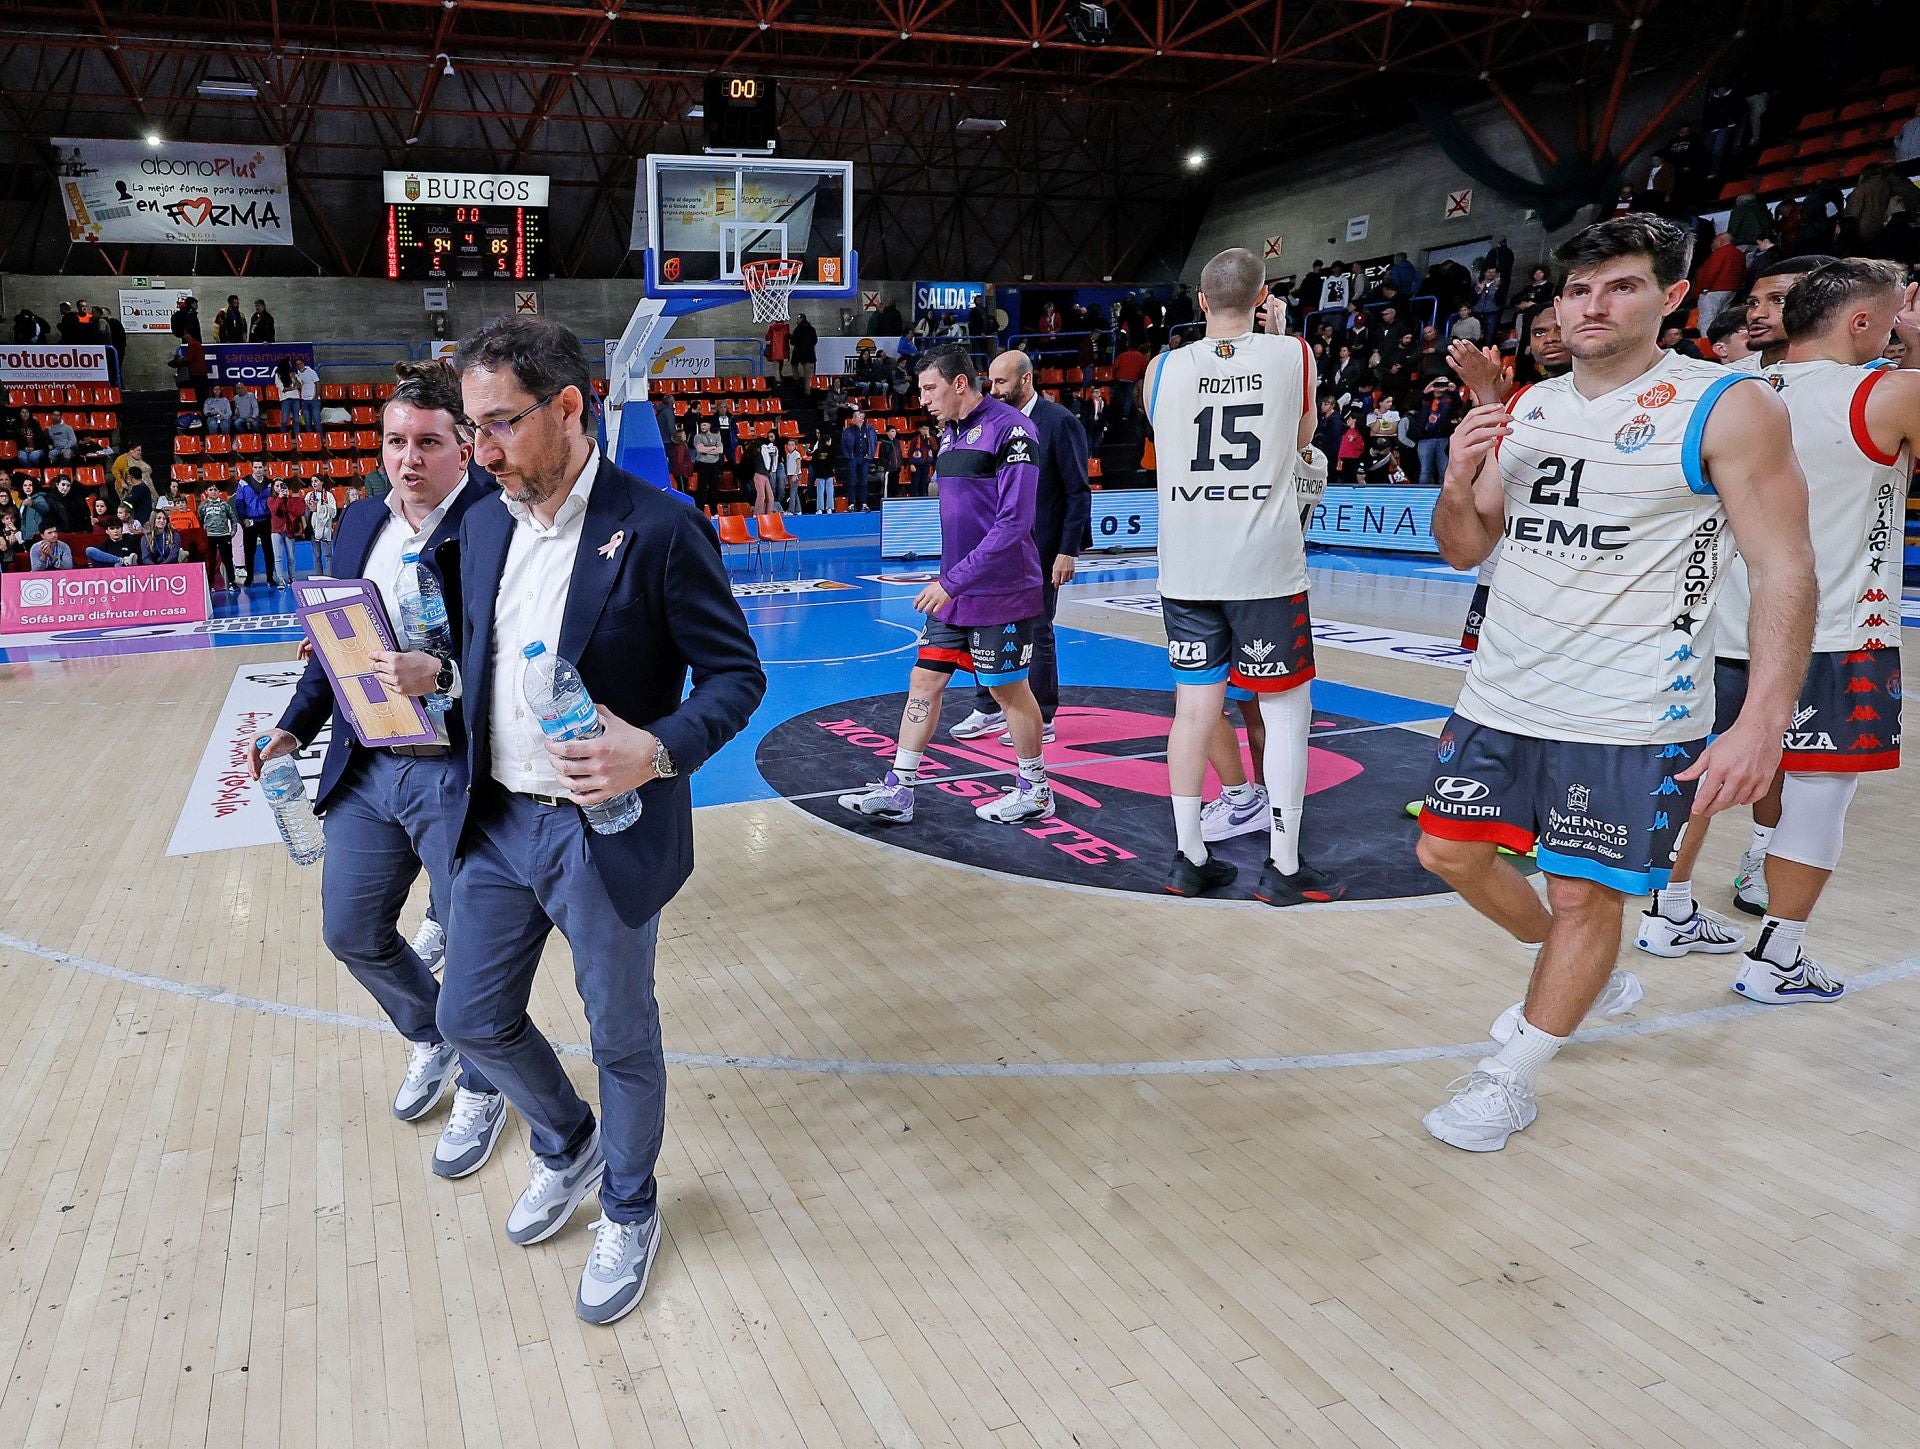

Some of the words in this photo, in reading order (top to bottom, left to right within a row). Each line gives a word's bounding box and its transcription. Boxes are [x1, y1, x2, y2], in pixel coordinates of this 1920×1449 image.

[141, 155, 256, 179] abonoPlus
[132, 183, 144, 192] La
[148, 184, 175, 197] mejor
[180, 184, 208, 194] forma
[213, 187, 234, 196] para
[238, 186, 275, 196] ponerte
[427, 178, 529, 202] BURGOS
[136, 199, 160, 212] en
[427, 226, 451, 234] LOCAL
[464, 234, 473, 244] 4
[434, 238, 450, 252] 94
[491, 239, 508, 254] 85
[498, 258, 505, 270] 5
[918, 288, 966, 310] SALIDA
[0, 348, 104, 368] rotucolor
[1190, 403, 1264, 472] 15
[1006, 453, 1031, 462] CRZA
[1529, 457, 1586, 508] 21
[1684, 518, 1718, 606] aspasia
[57, 574, 187, 597] famaliving
[58, 595, 117, 606] Burgos
[20, 614, 55, 624] Sofás
[58, 613, 85, 623] para
[88, 609, 140, 620] disfrutar
[160, 606, 186, 615] casa
[1238, 661, 1290, 677] CRZA
[1425, 794, 1501, 816] HYUNDAI
[1552, 822, 1628, 846] VALLADOLID
[1548, 837, 1583, 848] gusto
[1583, 841, 1597, 851] de
[1598, 844, 1624, 860] todos
